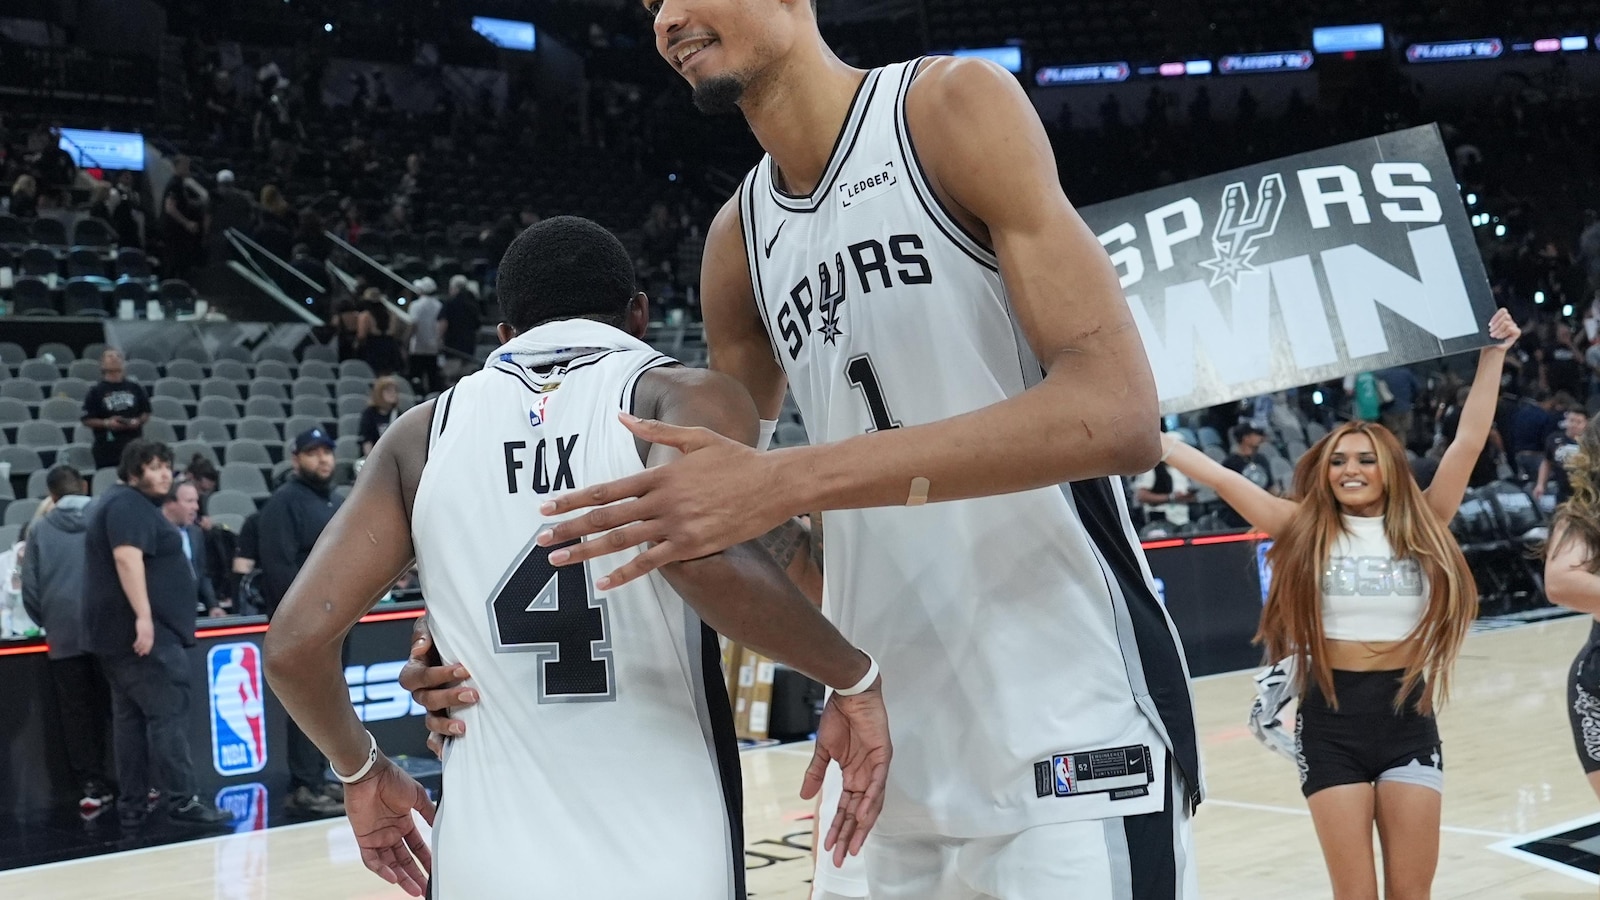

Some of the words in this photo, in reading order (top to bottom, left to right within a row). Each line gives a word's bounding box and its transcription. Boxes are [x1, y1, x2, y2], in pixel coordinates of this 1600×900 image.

[847, 171, 889, 199] LEDGER
[1096, 162, 1443, 290] SPURS
[777, 234, 933, 361] SPURS
[1125, 224, 1480, 401] WIN
[843, 352, 904, 434] 1
[503, 433, 580, 495] FOX
[484, 522, 617, 704] 4
[221, 742, 249, 767] NBA
[1077, 763, 1089, 772] 52
